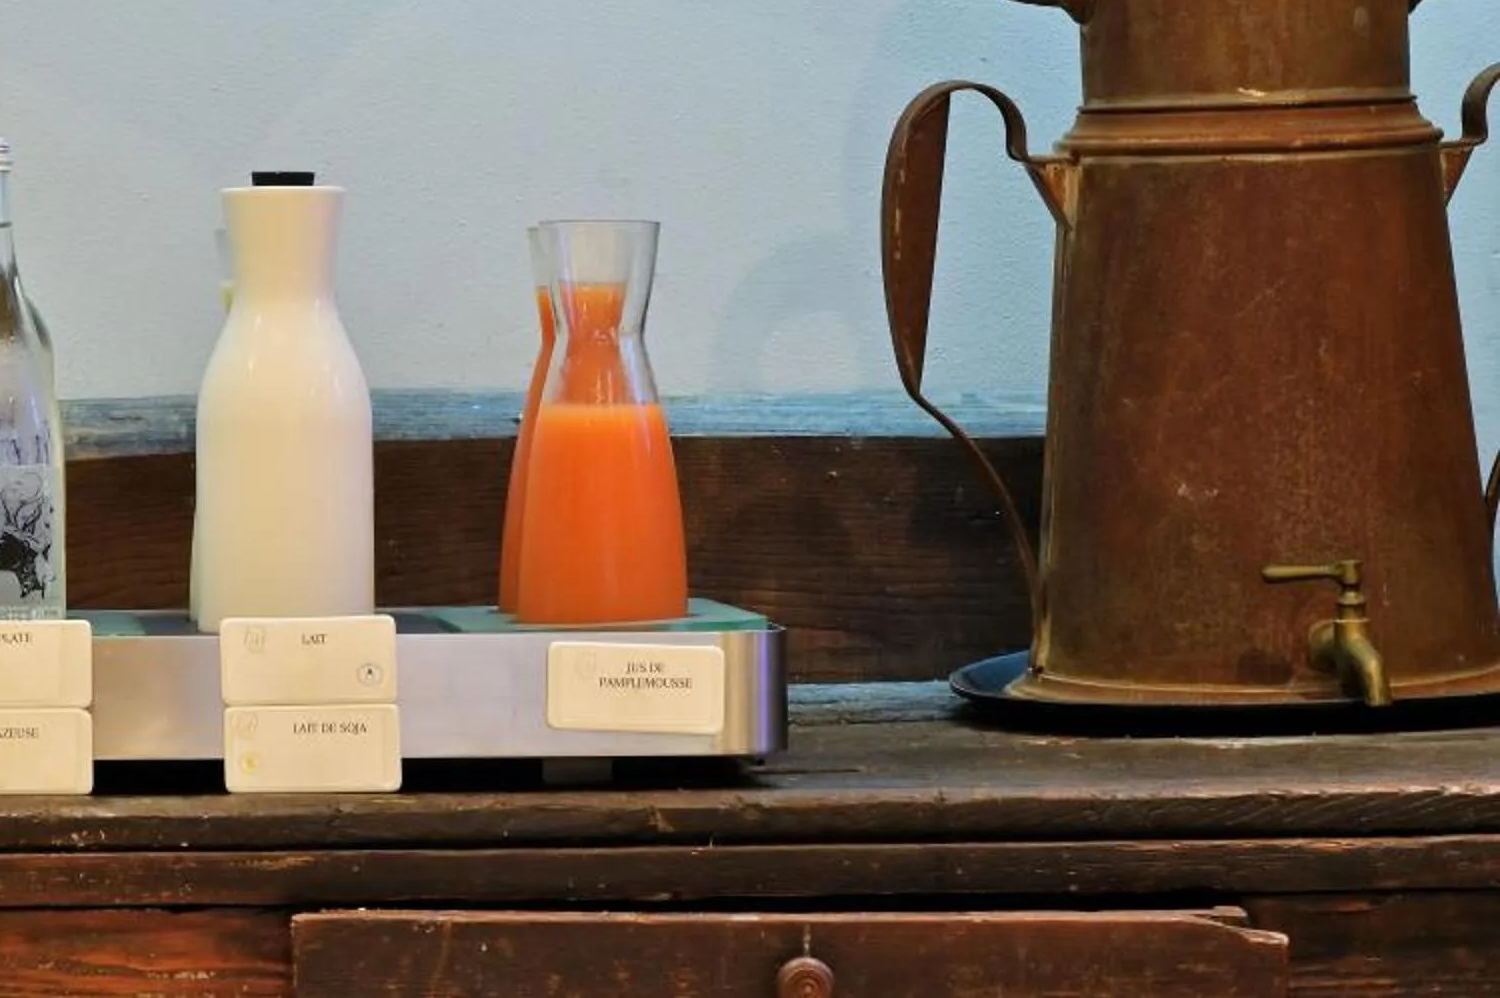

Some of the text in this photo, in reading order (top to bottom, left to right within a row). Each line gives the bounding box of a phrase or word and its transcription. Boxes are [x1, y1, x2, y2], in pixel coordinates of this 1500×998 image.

[302, 634, 328, 645] LAIT
[626, 662, 648, 674] JUS
[599, 677, 693, 689] PAMPLEMOUSSE
[293, 722, 368, 735] LAIT DE SOJA
